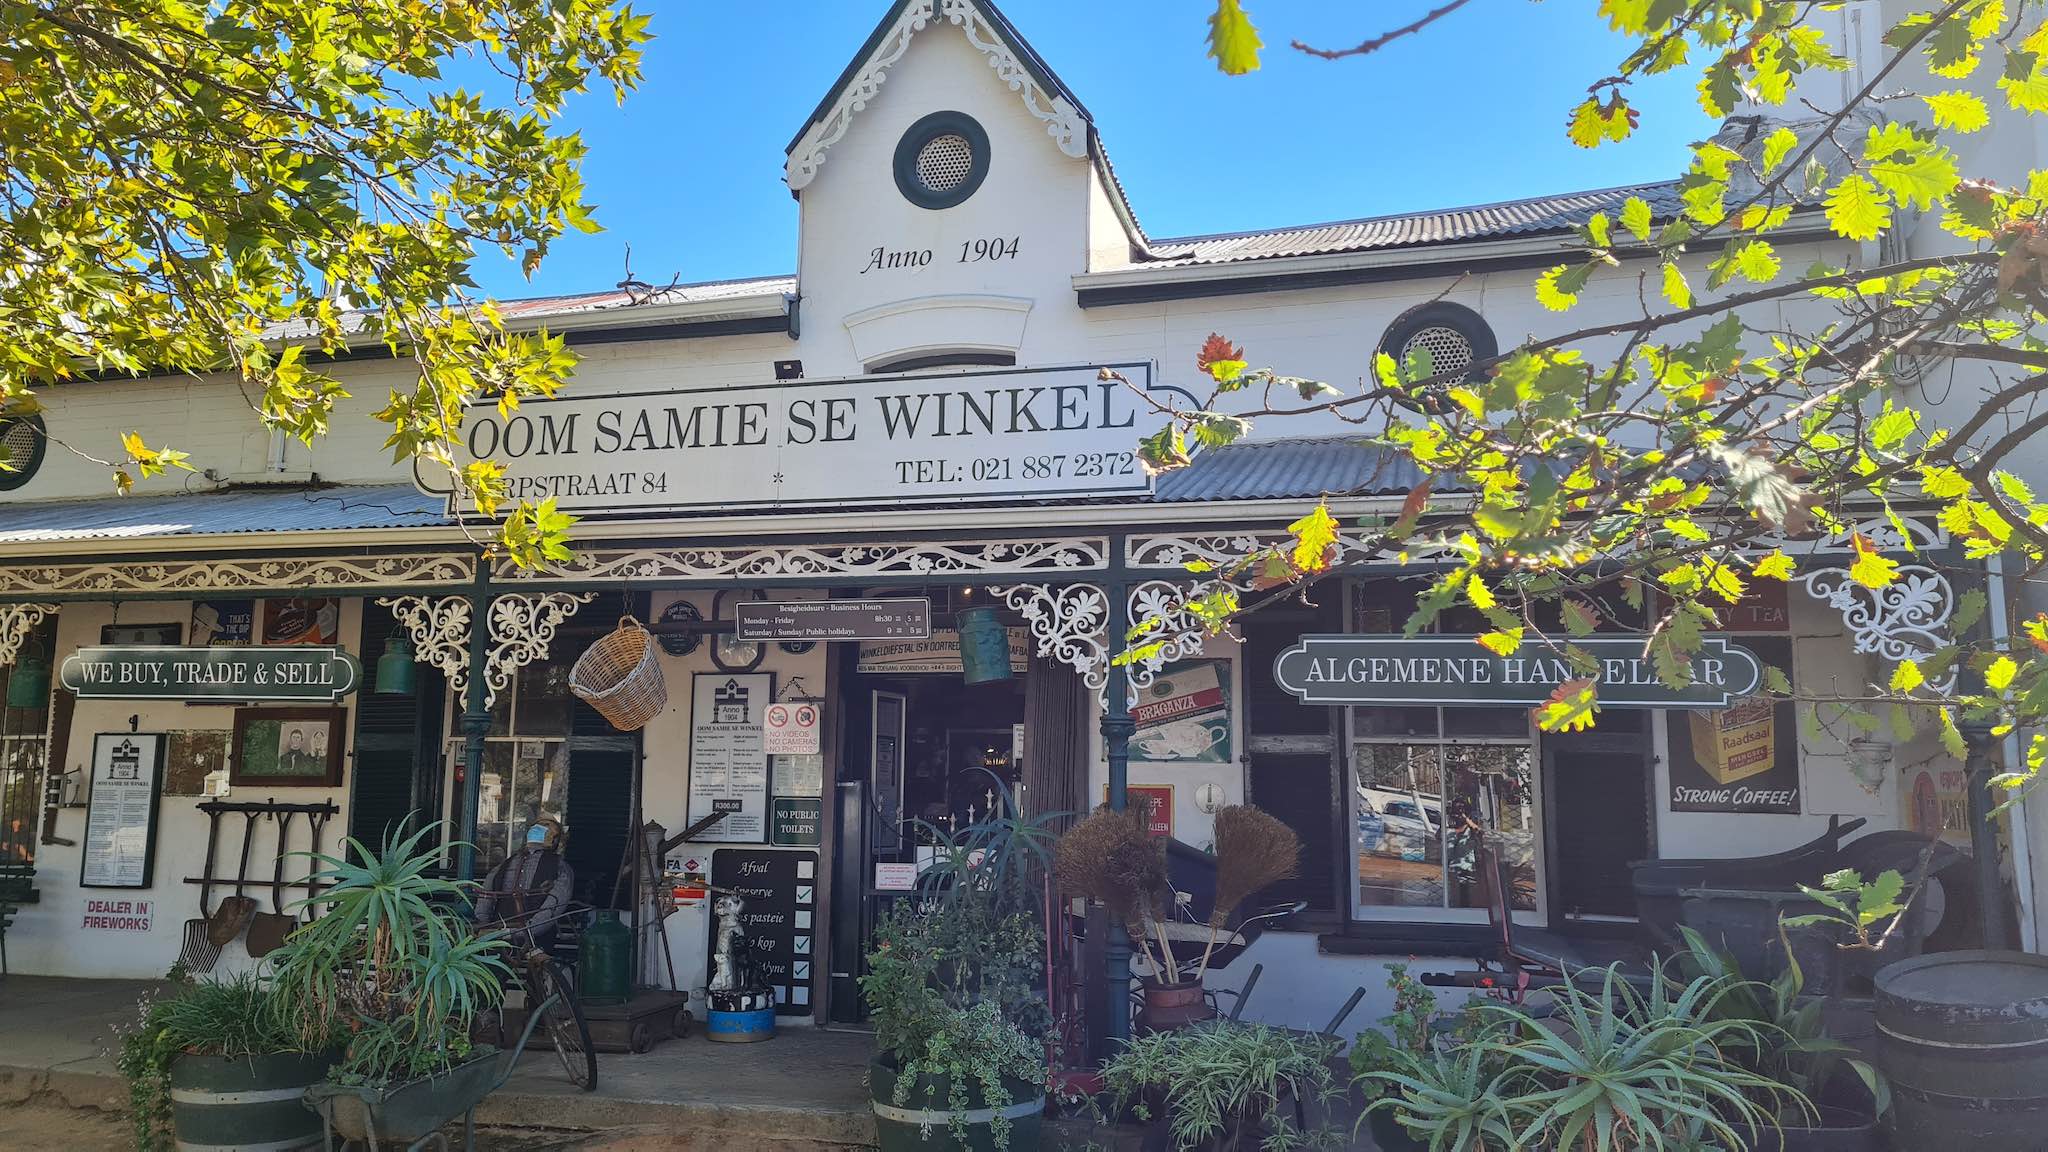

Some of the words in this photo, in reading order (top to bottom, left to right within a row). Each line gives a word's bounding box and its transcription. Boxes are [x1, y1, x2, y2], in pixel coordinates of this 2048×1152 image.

[859, 246, 933, 274] Anno
[957, 235, 1021, 263] 1904
[468, 413, 582, 459] OOM
[594, 401, 768, 454] SAMIE
[787, 398, 857, 445] SE
[874, 382, 1136, 441] WINKEL
[895, 460, 964, 484] TEL:
[971, 457, 1013, 482] 021
[1022, 454, 1067, 480] 887
[1074, 452, 1135, 477] 2372
[641, 471, 668, 494] 84
[831, 603, 860, 611] Business
[861, 603, 882, 611] Hours
[743, 617, 769, 626] Monday
[775, 616, 794, 625] Friday
[743, 629, 772, 638] Saturday
[806, 627, 826, 636] Public
[828, 628, 855, 637] holidays
[80, 662, 114, 684] WE
[119, 662, 168, 687] BUY,
[173, 662, 247, 684] TRADE
[253, 662, 269, 684] &
[274, 662, 334, 685] SELL
[1304, 657, 1491, 683] ALGEMENE
[1137, 695, 1198, 721] BRAGANZA
[782, 730, 809, 738] VIDEOS
[1722, 724, 1771, 752] Raadsaal
[782, 745, 813, 753] PHOTOS
[1673, 785, 1731, 803] STRONG
[1732, 786, 1797, 806] COFFEE!
[776, 810, 789, 819] NO
[790, 810, 819, 819] PUBLIC
[780, 825, 814, 834] TOILETS
[737, 860, 771, 876] Afval
[88, 900, 132, 914] DEALER
[135, 902, 148, 914] IN
[83, 916, 149, 931] FIREWORKS
[749, 911, 784, 925] pasteie
[757, 935, 776, 951] kop
